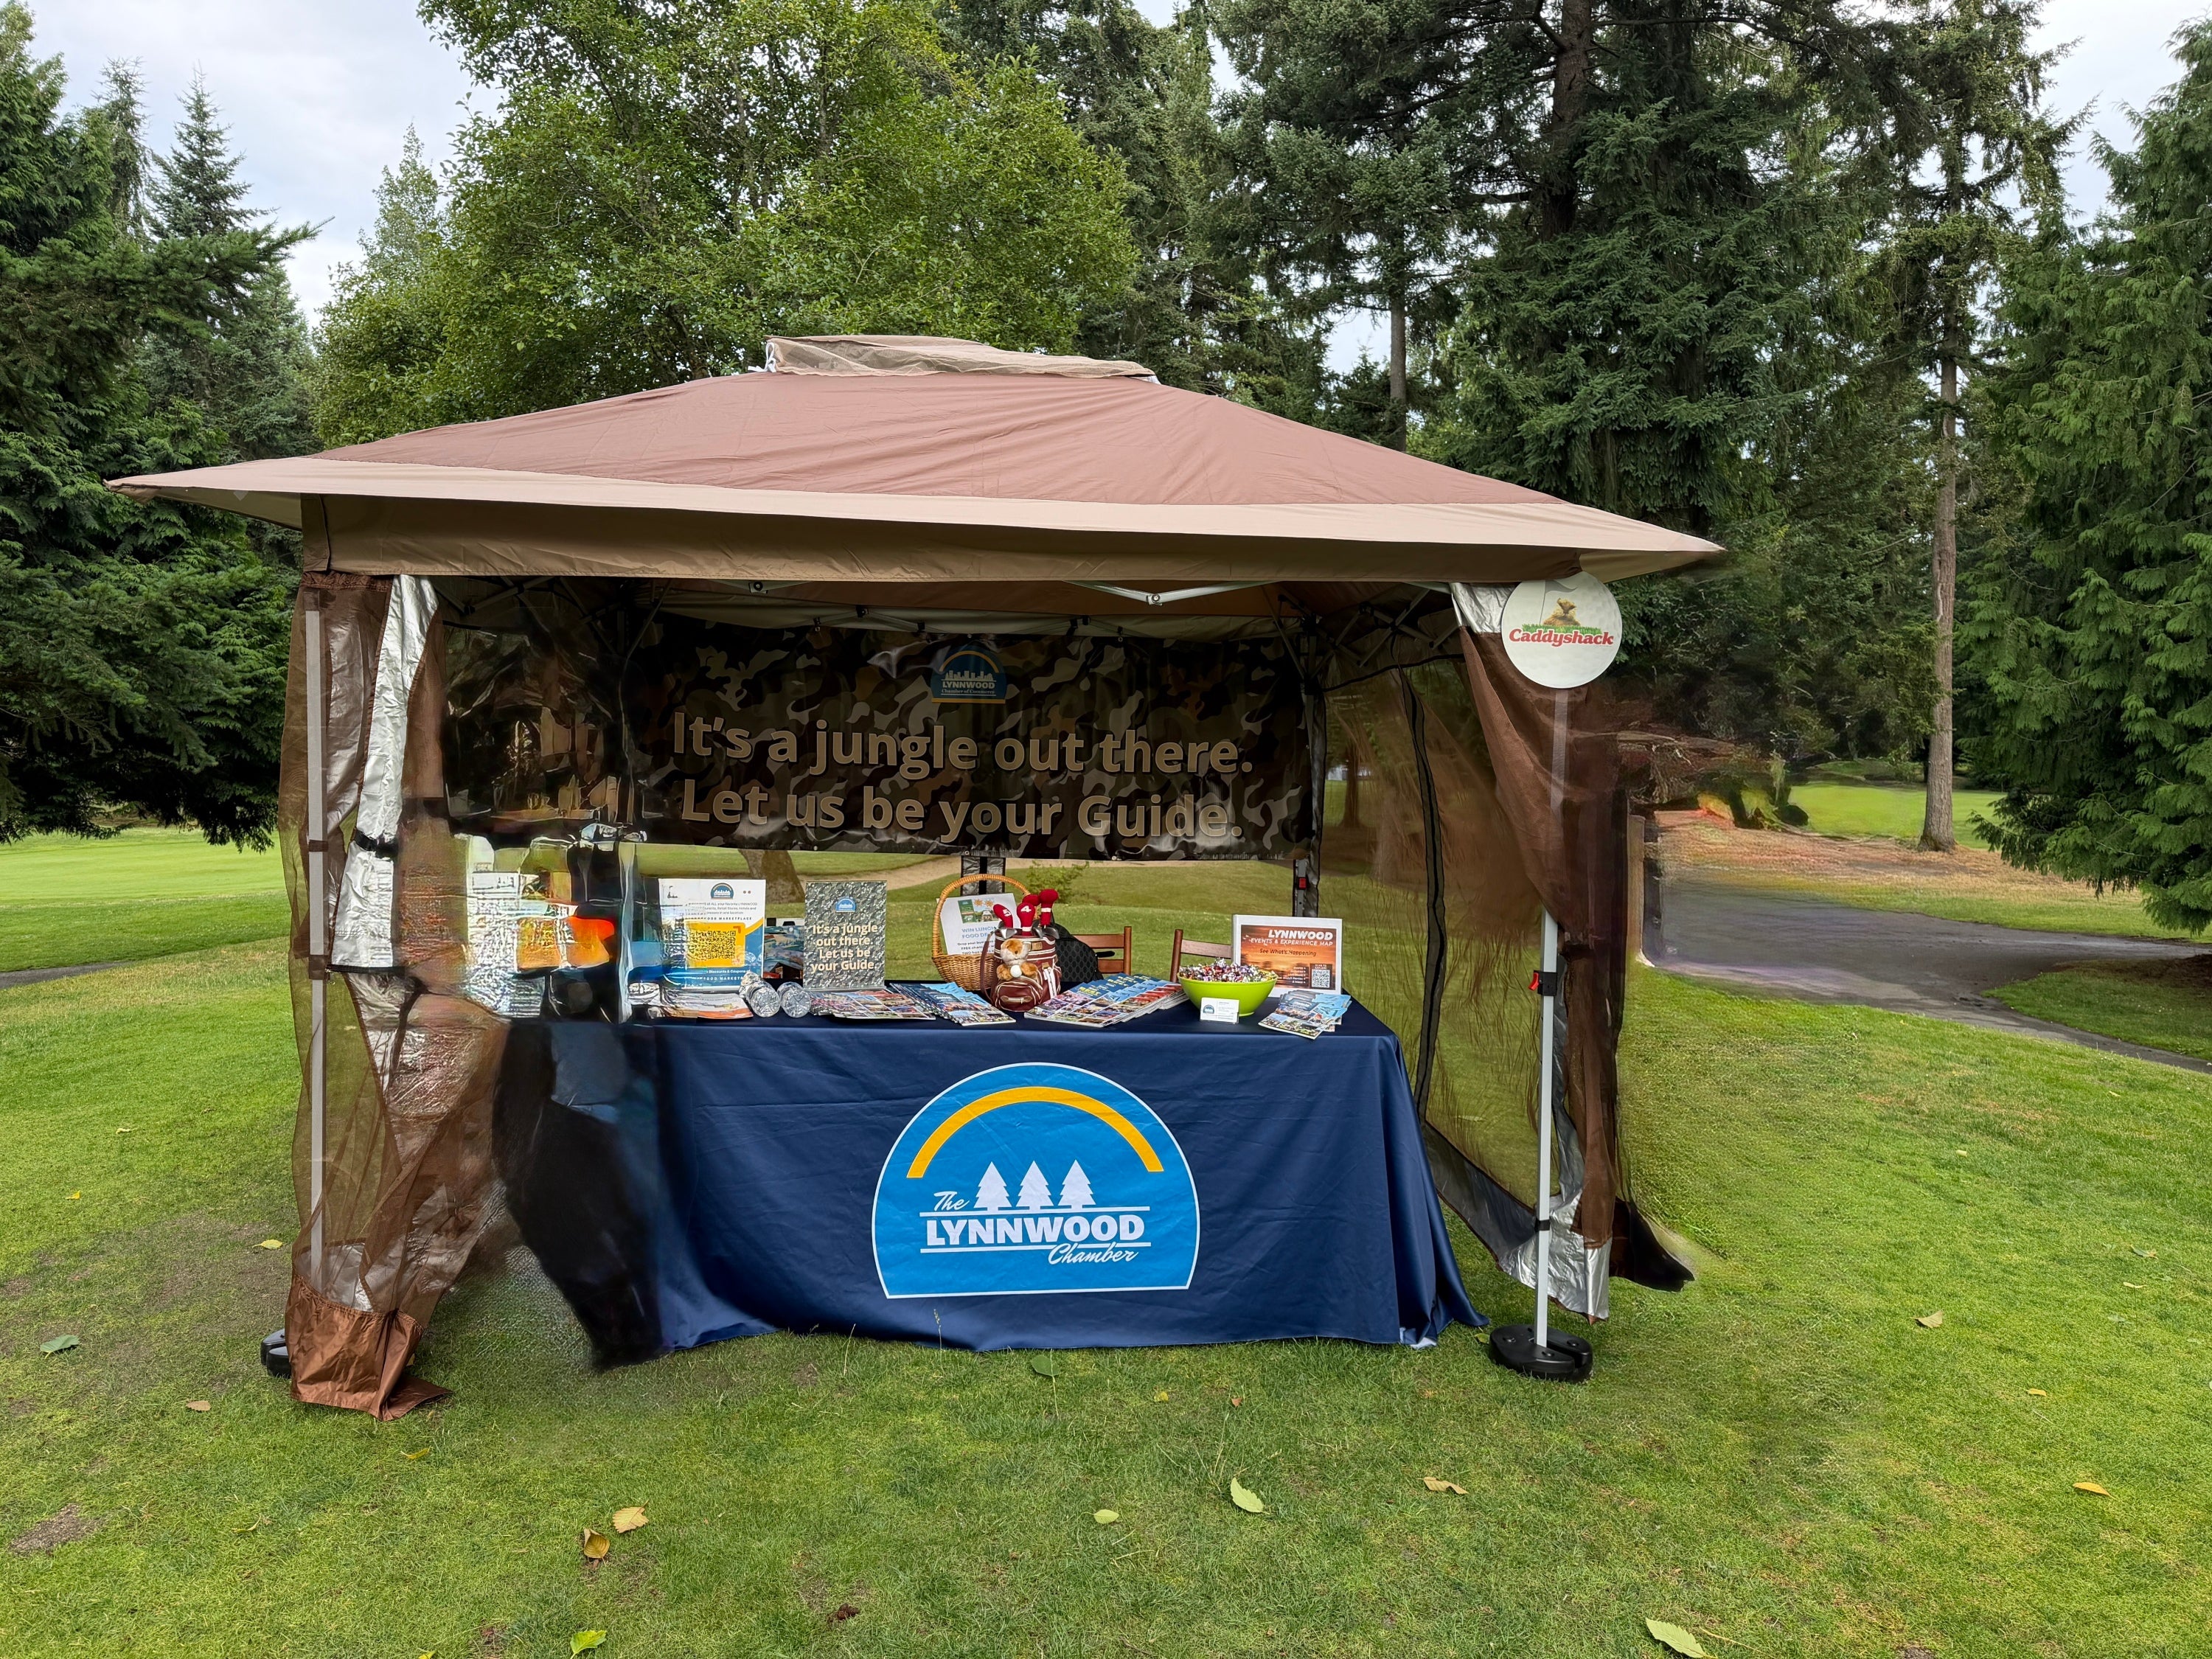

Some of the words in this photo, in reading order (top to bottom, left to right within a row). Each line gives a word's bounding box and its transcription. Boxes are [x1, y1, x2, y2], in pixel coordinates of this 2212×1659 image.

[1509, 628, 1614, 647] Caddyshack
[942, 681, 995, 689] LYNNWOOD
[674, 712, 752, 759] It's
[768, 730, 798, 762] a
[809, 719, 978, 780] jungle
[994, 732, 1085, 772] out
[1099, 729, 1253, 773] there.
[681, 779, 769, 826] Let
[786, 794, 845, 828] us
[863, 785, 925, 830] be
[938, 801, 1062, 844] your
[1077, 793, 1243, 838] Guide.
[1003, 908, 1012, 917] 5
[812, 924, 830, 934] It's
[841, 922, 878, 936] jungle
[1268, 929, 1333, 940] LYNNWOOD
[816, 937, 836, 946] out
[839, 936, 873, 945] there.
[819, 949, 838, 959] Let
[841, 950, 854, 958] us
[856, 947, 871, 957] be
[811, 961, 838, 973] your
[933, 1190, 970, 1211] The
[927, 1214, 1145, 1246] LYNNWOOD
[1048, 1242, 1138, 1265] Chamber
